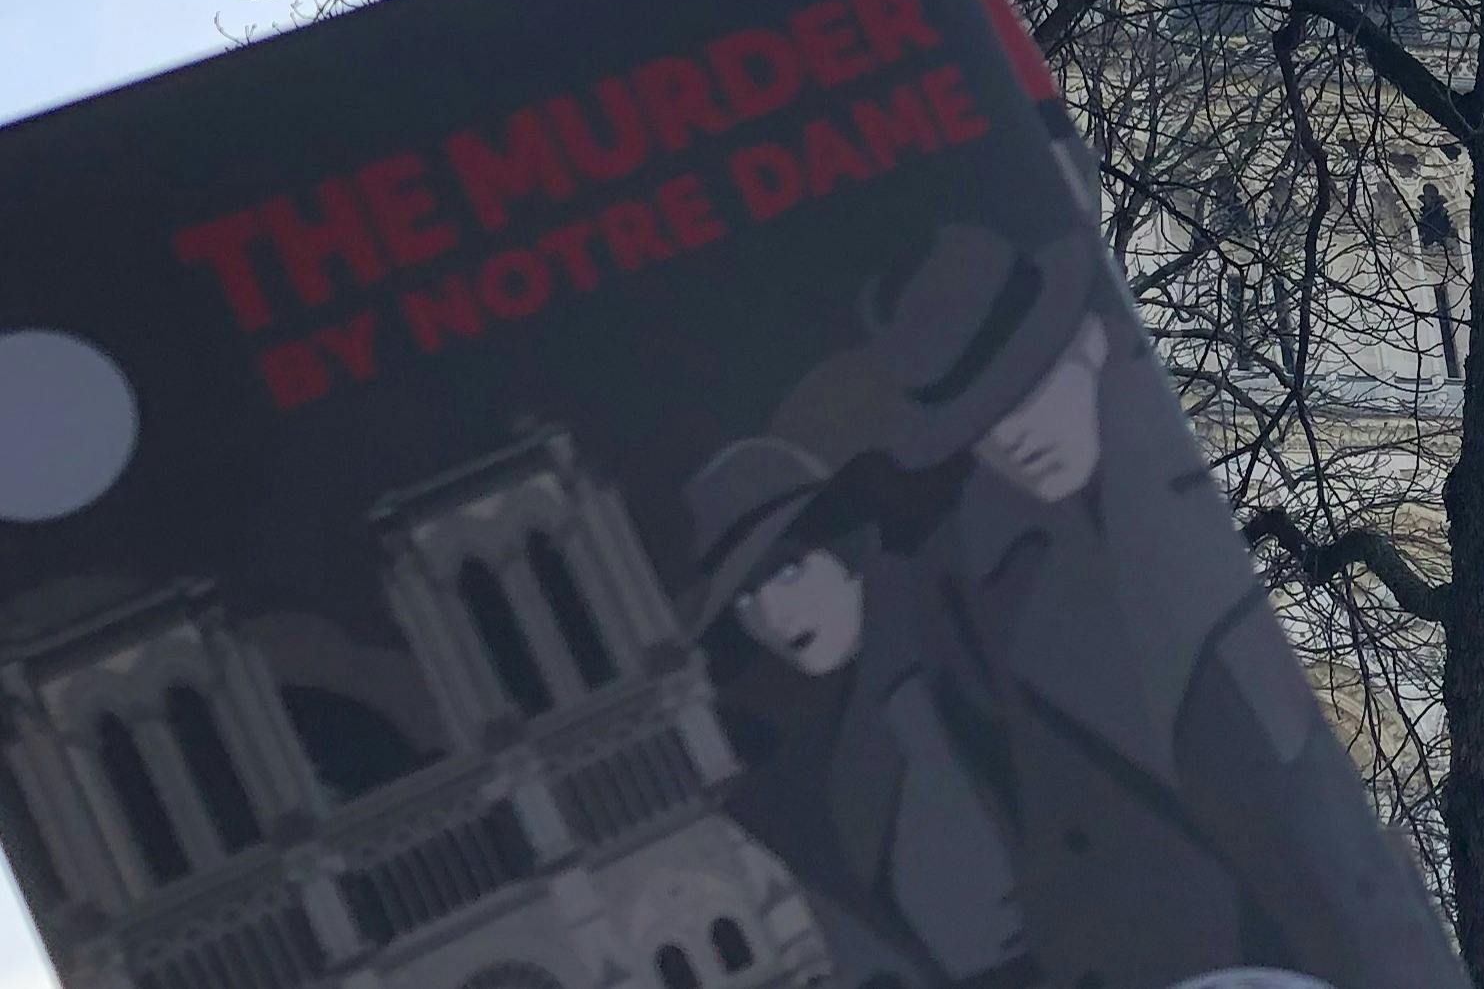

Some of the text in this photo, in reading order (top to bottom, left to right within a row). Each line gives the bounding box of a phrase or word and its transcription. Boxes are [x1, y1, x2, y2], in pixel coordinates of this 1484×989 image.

[174, 151, 459, 331] THE
[259, 66, 991, 410] BY NOTRE DAME
